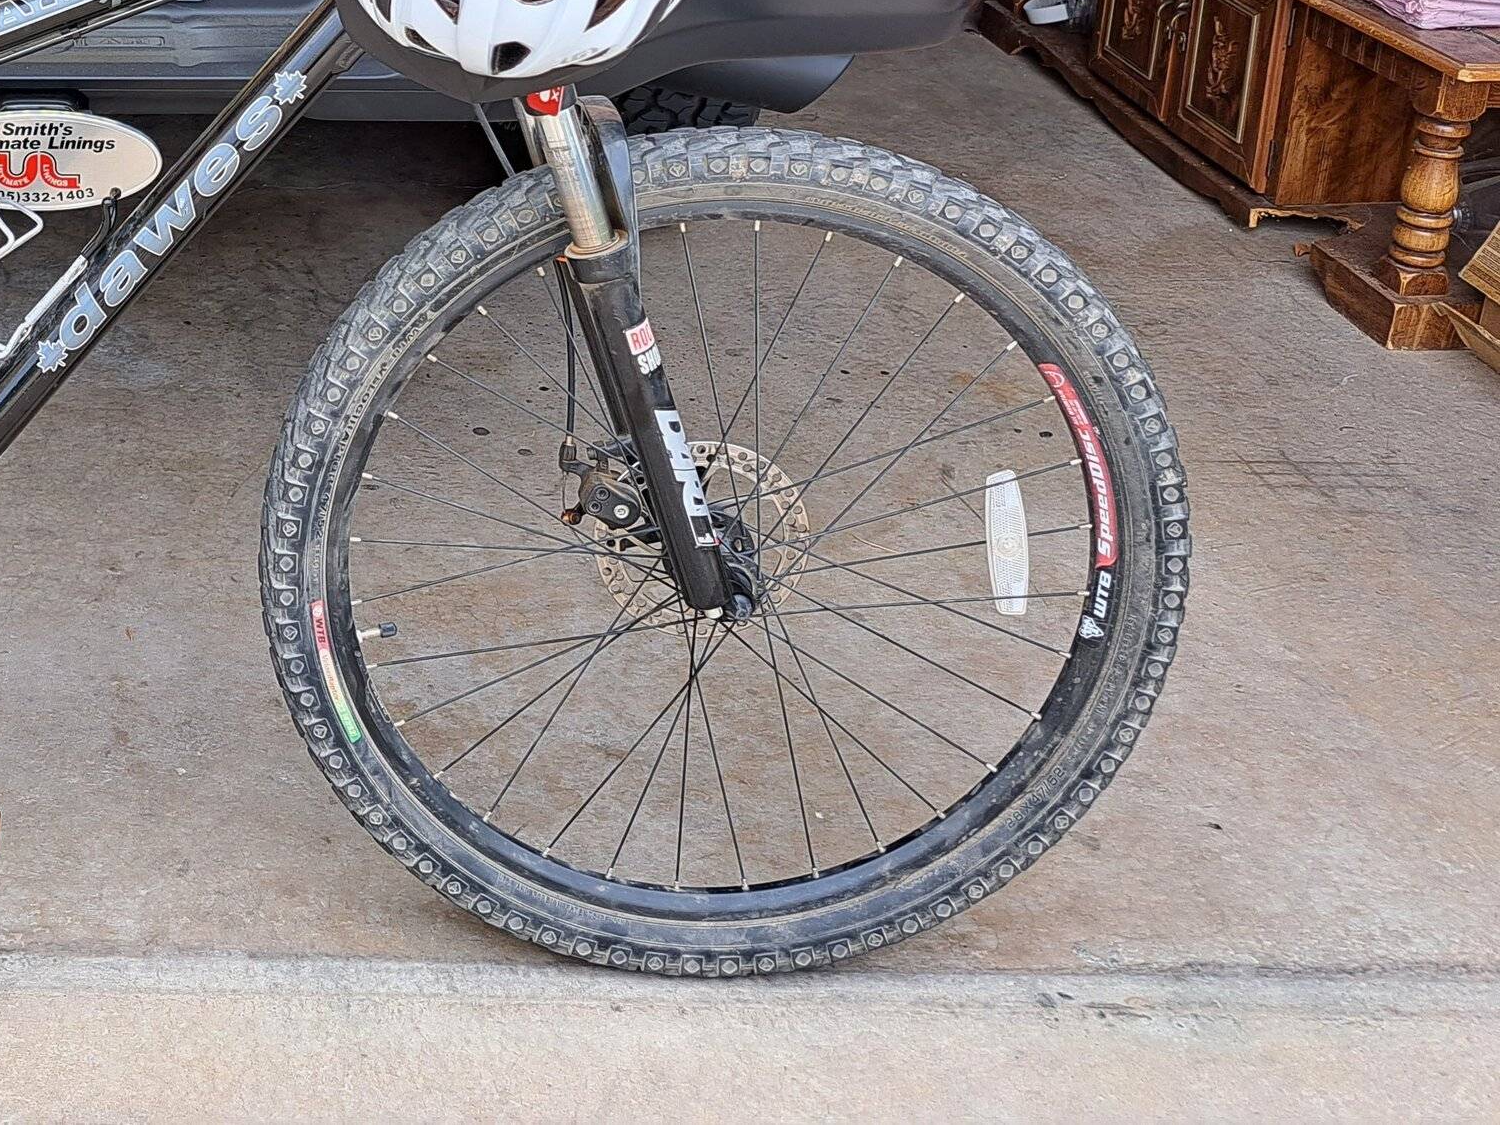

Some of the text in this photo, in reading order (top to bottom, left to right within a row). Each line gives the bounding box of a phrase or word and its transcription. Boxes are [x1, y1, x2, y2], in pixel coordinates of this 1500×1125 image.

[2, 123, 73, 136] Smith's
[48, 137, 115, 153] Linings
[43, 164, 68, 187] LININGS
[59, 95, 283, 351] dawes
[1080, 427, 1116, 561] SpeedDisc
[1094, 571, 1112, 618] WTB
[315, 618, 326, 644] WTB
